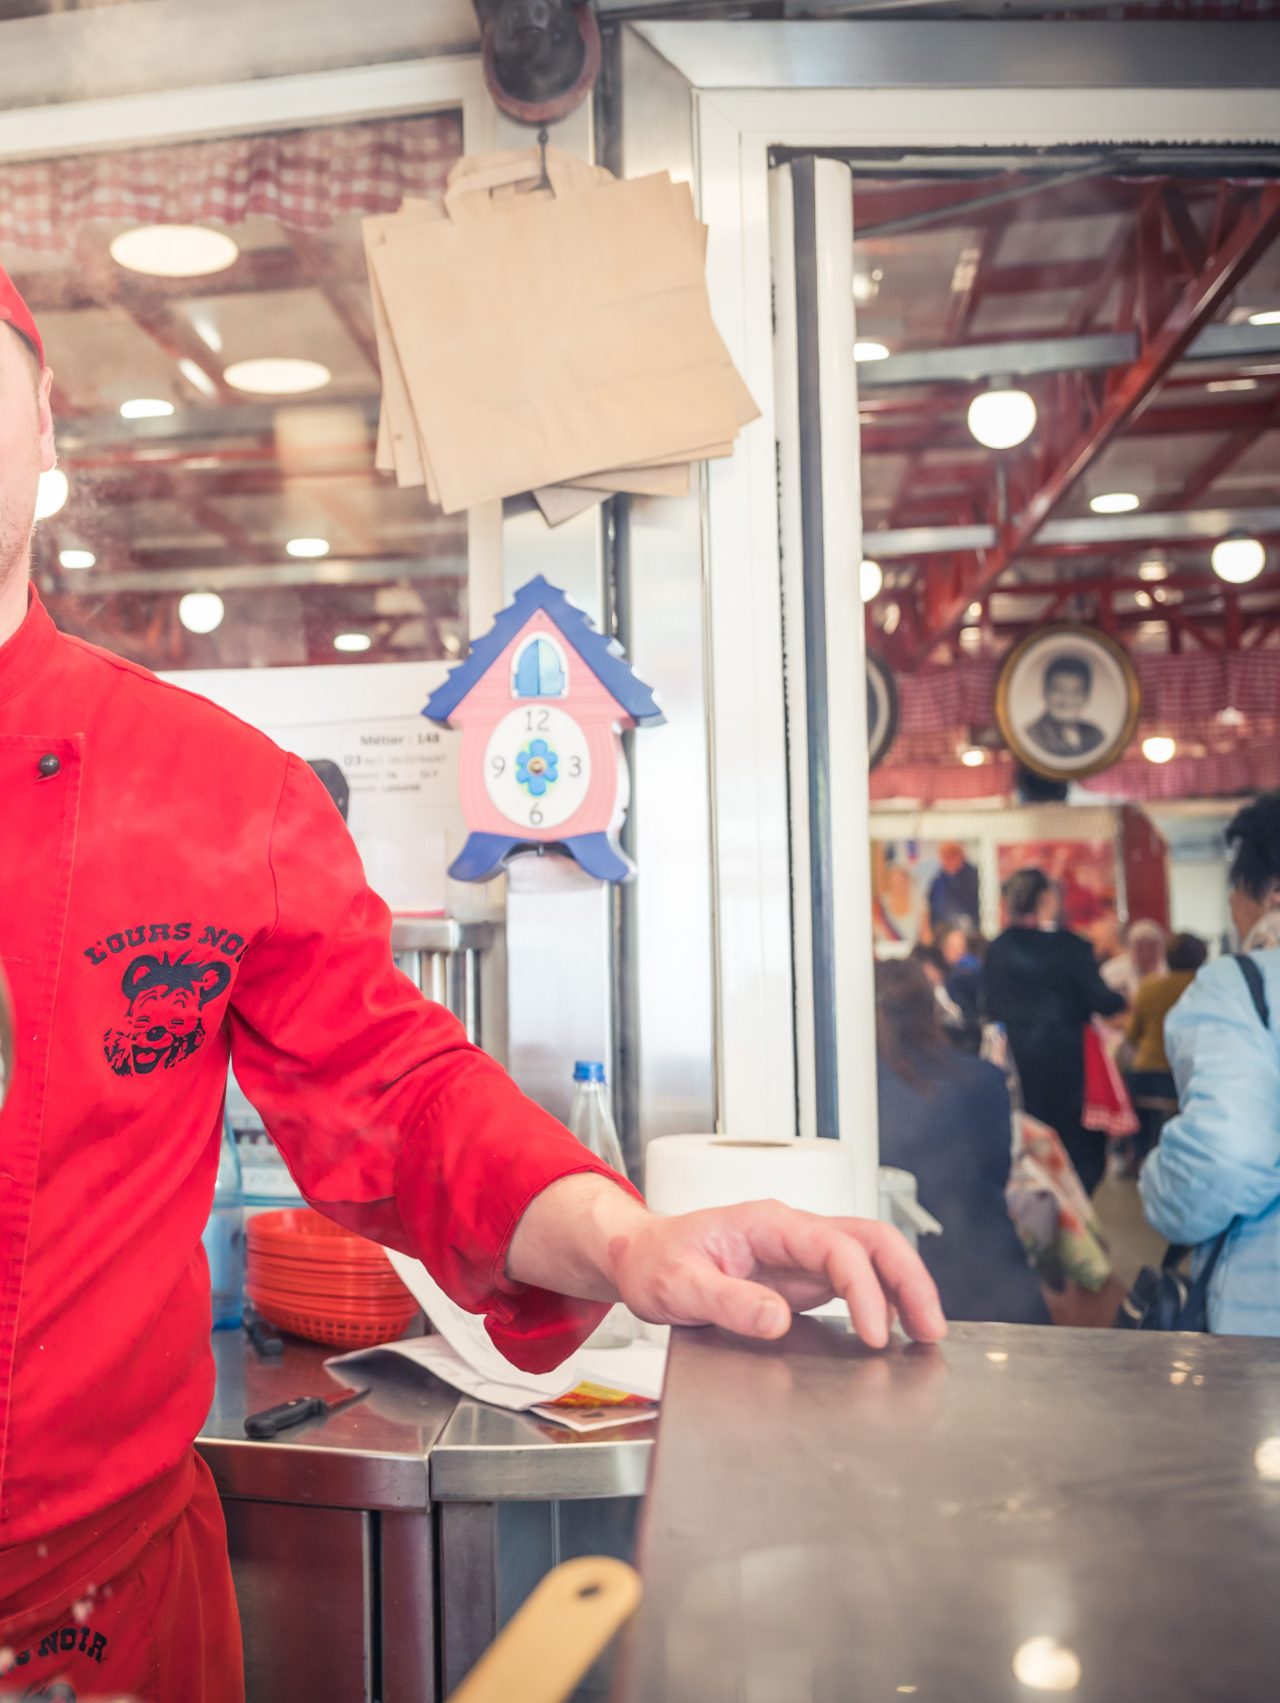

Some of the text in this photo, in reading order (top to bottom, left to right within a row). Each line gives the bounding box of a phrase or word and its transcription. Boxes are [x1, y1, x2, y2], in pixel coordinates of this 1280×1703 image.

[526, 709, 549, 732] 12
[491, 755, 581, 778] 9 3
[529, 802, 543, 825] 6
[84, 922, 192, 966] L'OURS
[38, 1626, 108, 1664] NOIR
